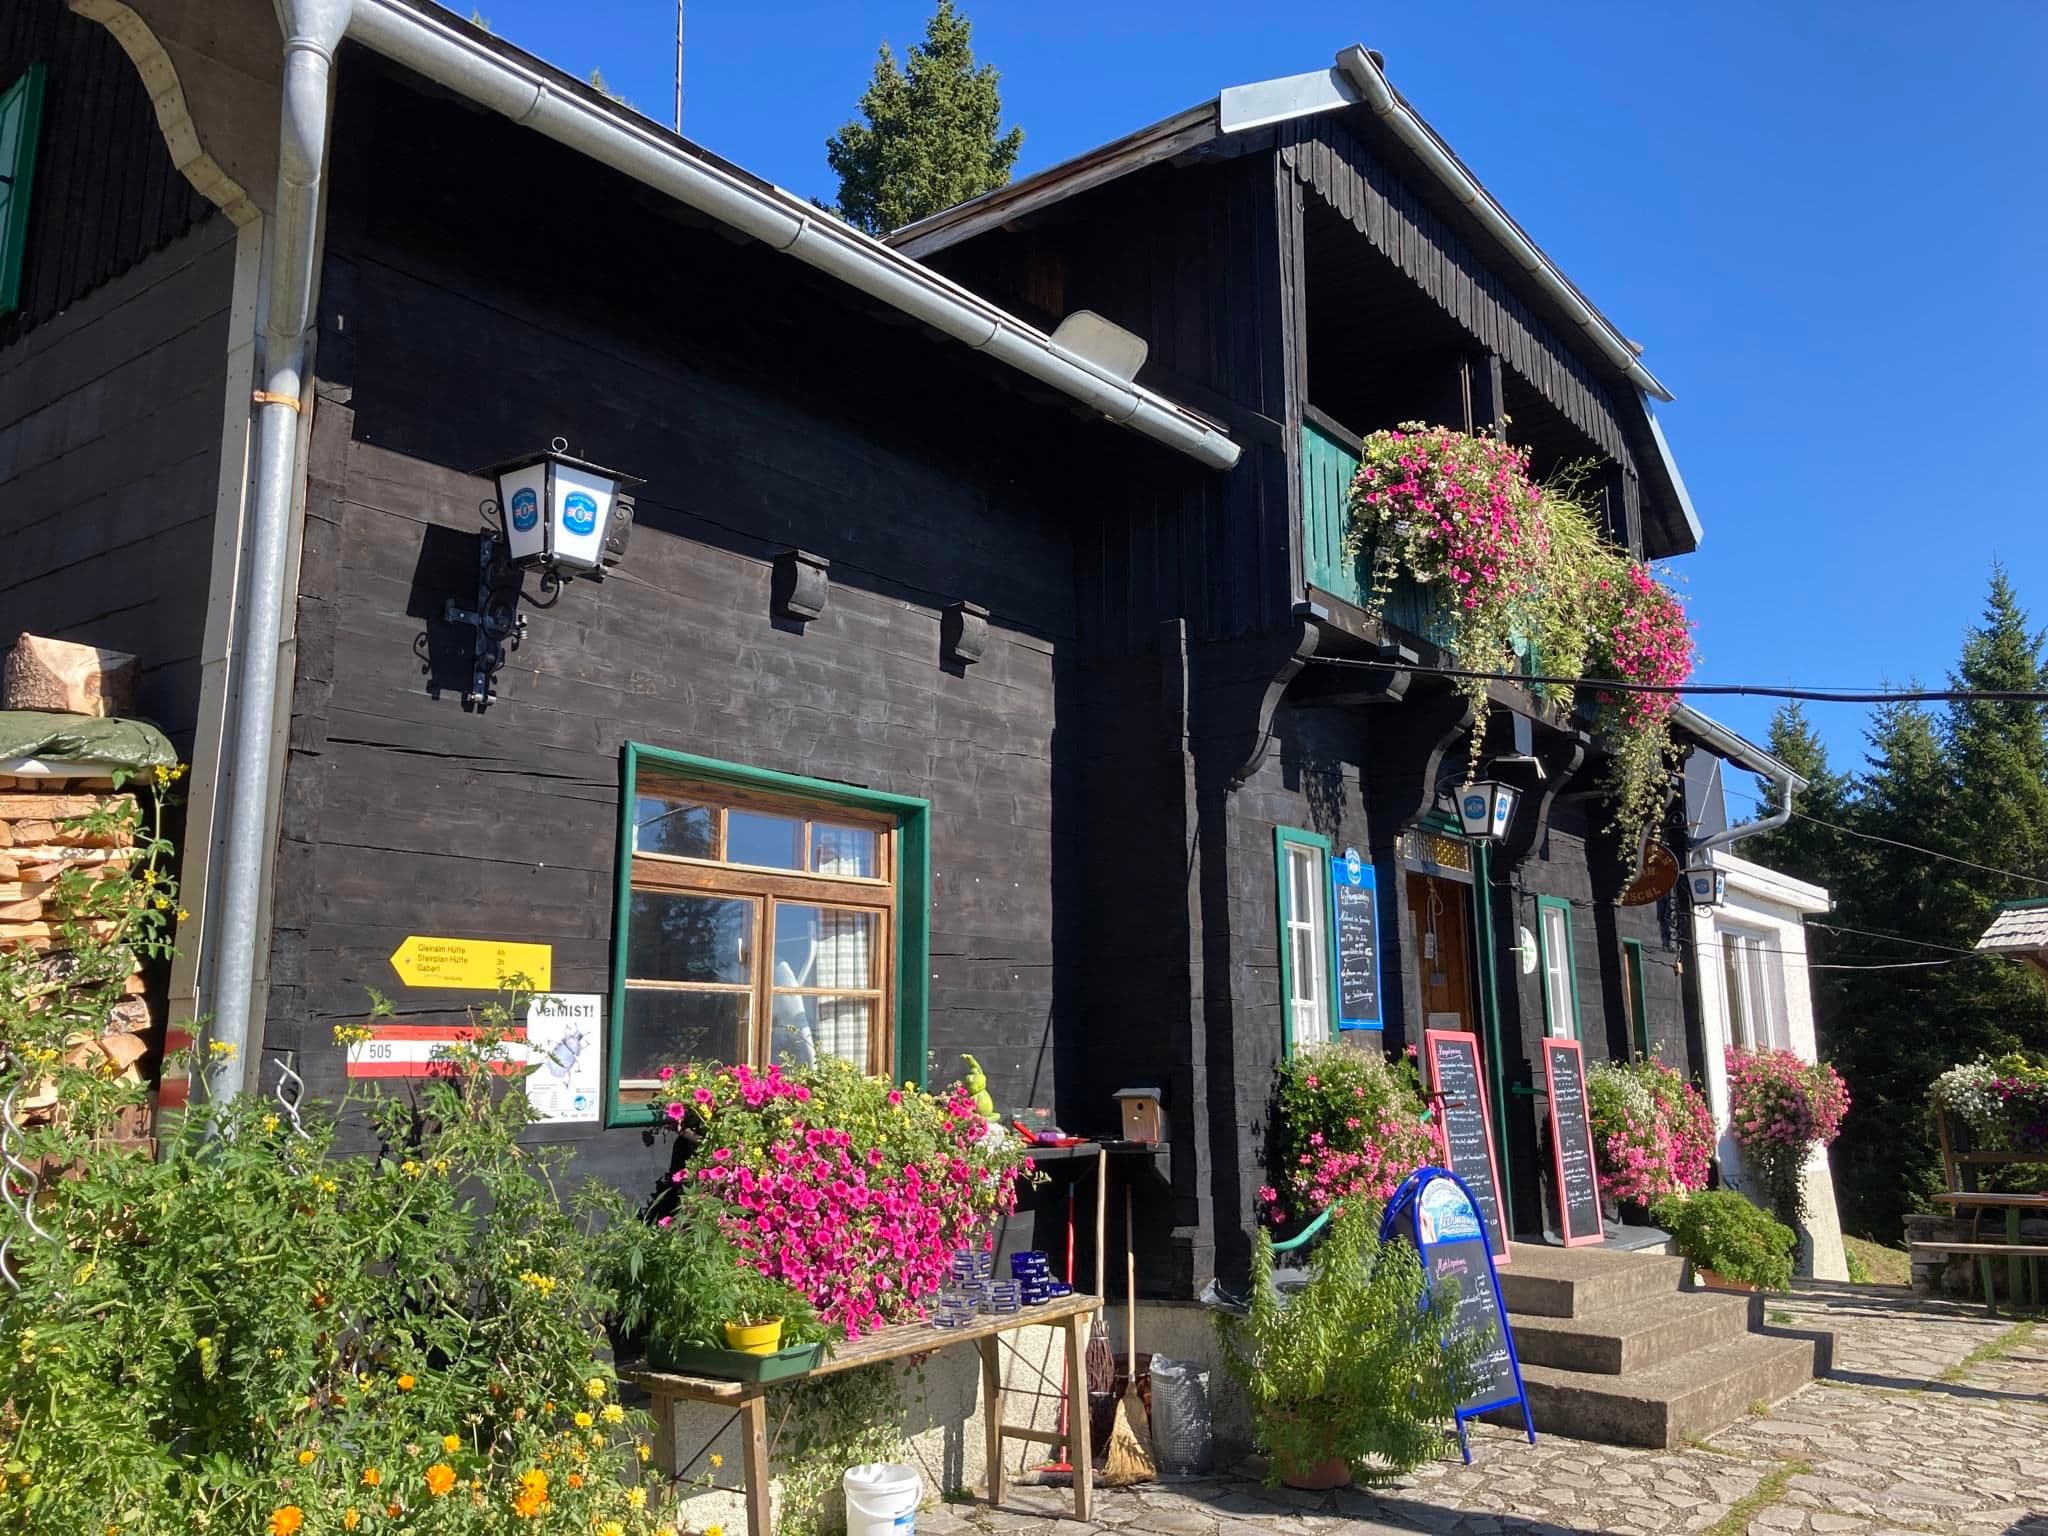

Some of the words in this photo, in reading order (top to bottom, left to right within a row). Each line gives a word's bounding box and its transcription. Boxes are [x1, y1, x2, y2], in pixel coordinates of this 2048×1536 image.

[417, 944, 446, 953] Gleinalm
[447, 945, 466, 954] Hütte
[449, 955, 468, 964] Hütte
[369, 1044, 392, 1059] 505
